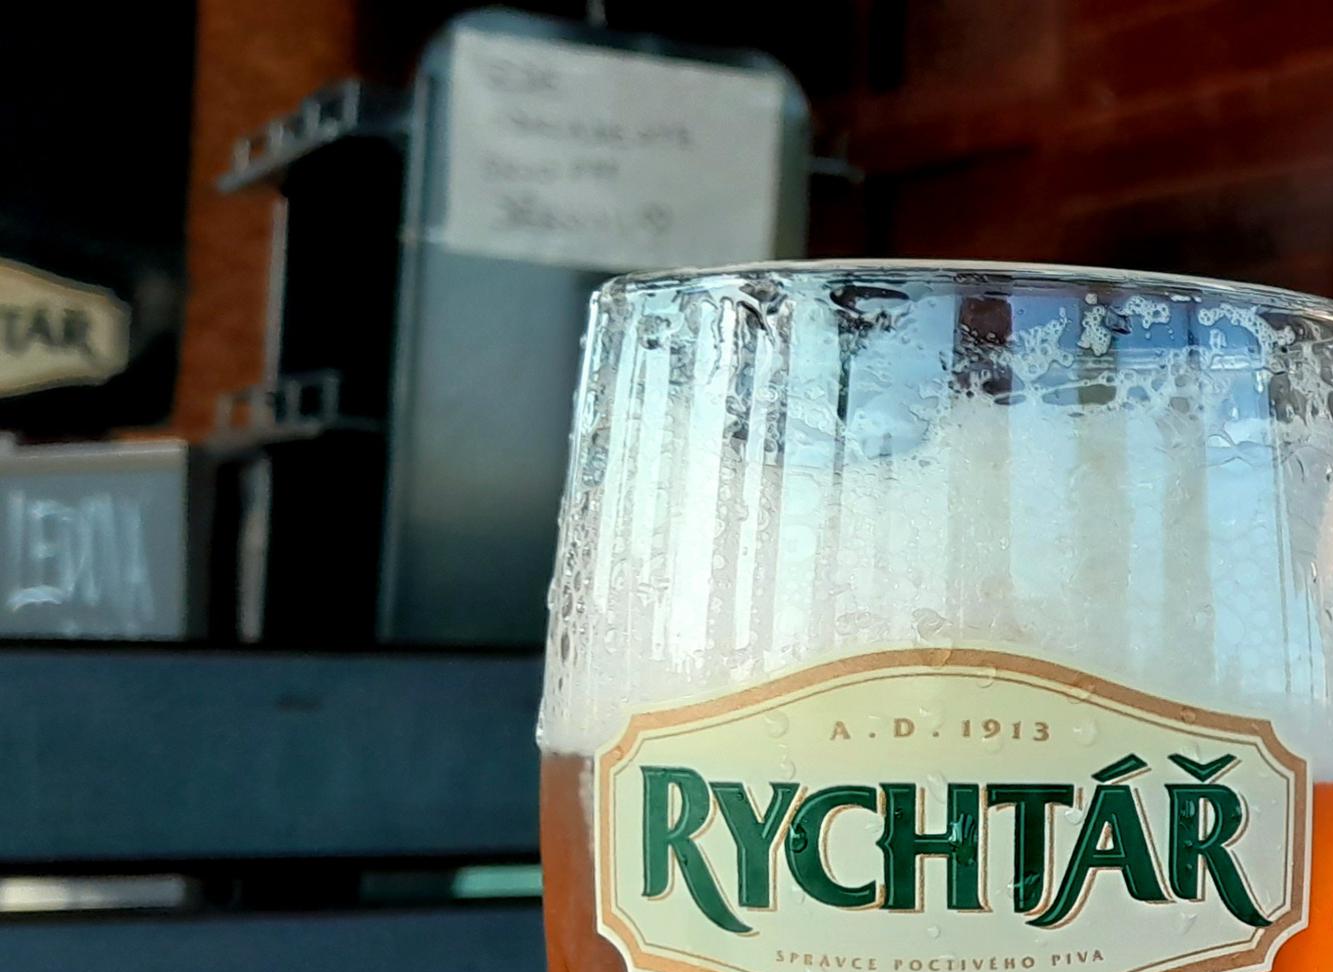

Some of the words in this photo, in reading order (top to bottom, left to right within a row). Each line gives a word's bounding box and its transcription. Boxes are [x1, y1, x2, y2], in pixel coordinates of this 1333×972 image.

[960, 718, 1050, 742] 1913
[639, 752, 1274, 936] RYCHTÁŘ
[893, 955, 1036, 972] POCTIVÉHO
[1050, 949, 1105, 967] PIVA
